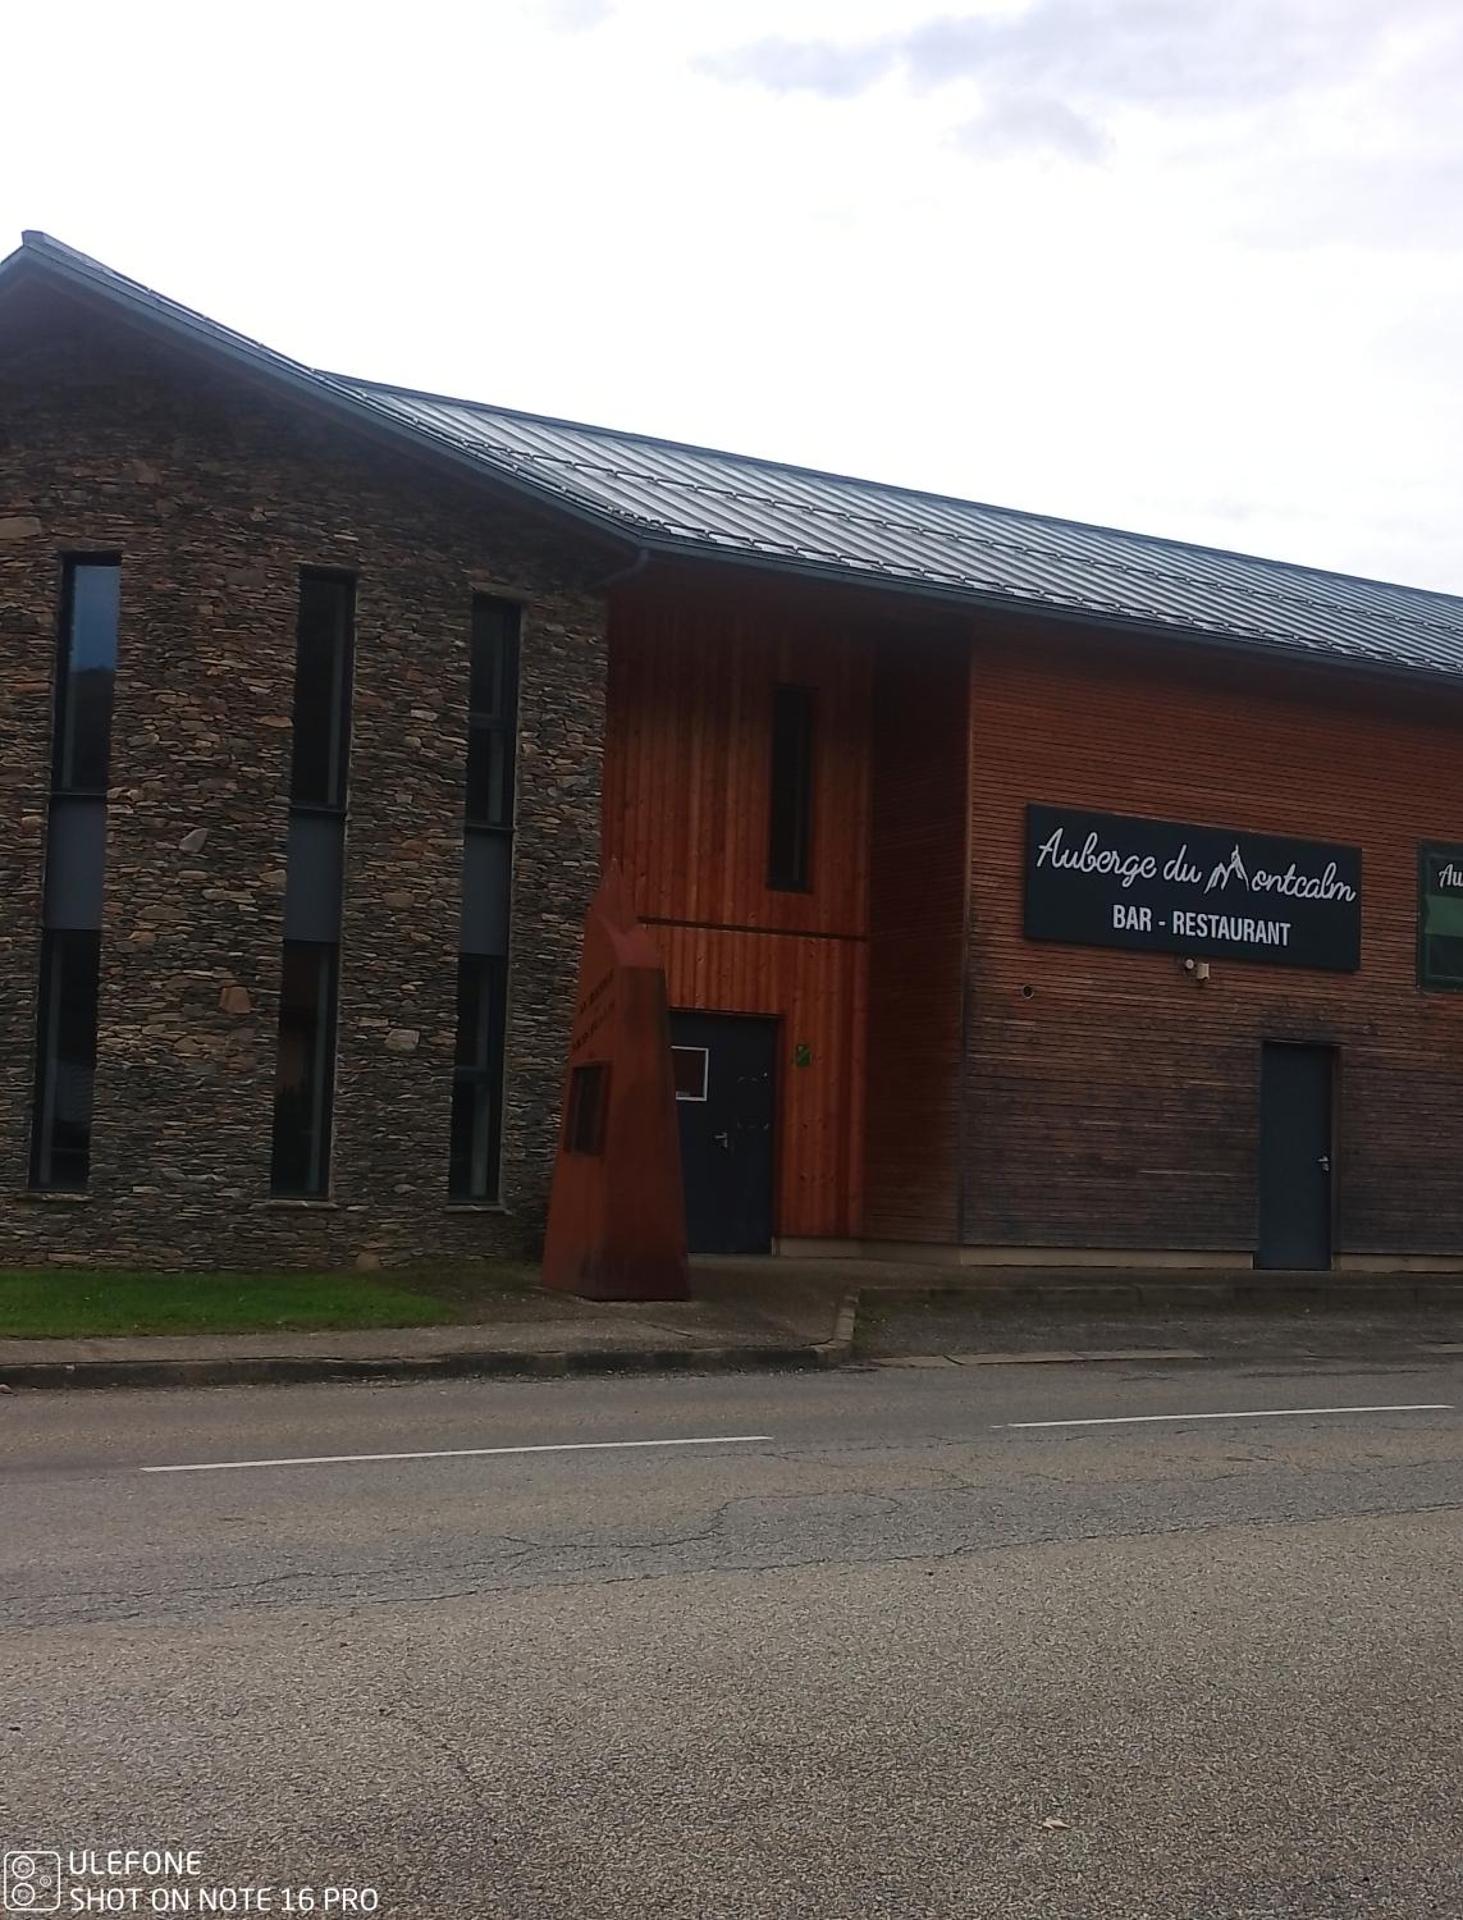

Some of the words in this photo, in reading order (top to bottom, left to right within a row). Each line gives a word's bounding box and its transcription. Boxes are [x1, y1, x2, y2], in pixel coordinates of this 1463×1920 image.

[1036, 827, 1158, 888] Auberge
[1163, 844, 1202, 883] du
[1203, 843, 1357, 902] Montcalm
[1113, 904, 1152, 932] BAR
[1172, 910, 1291, 947] RESTAURANT
